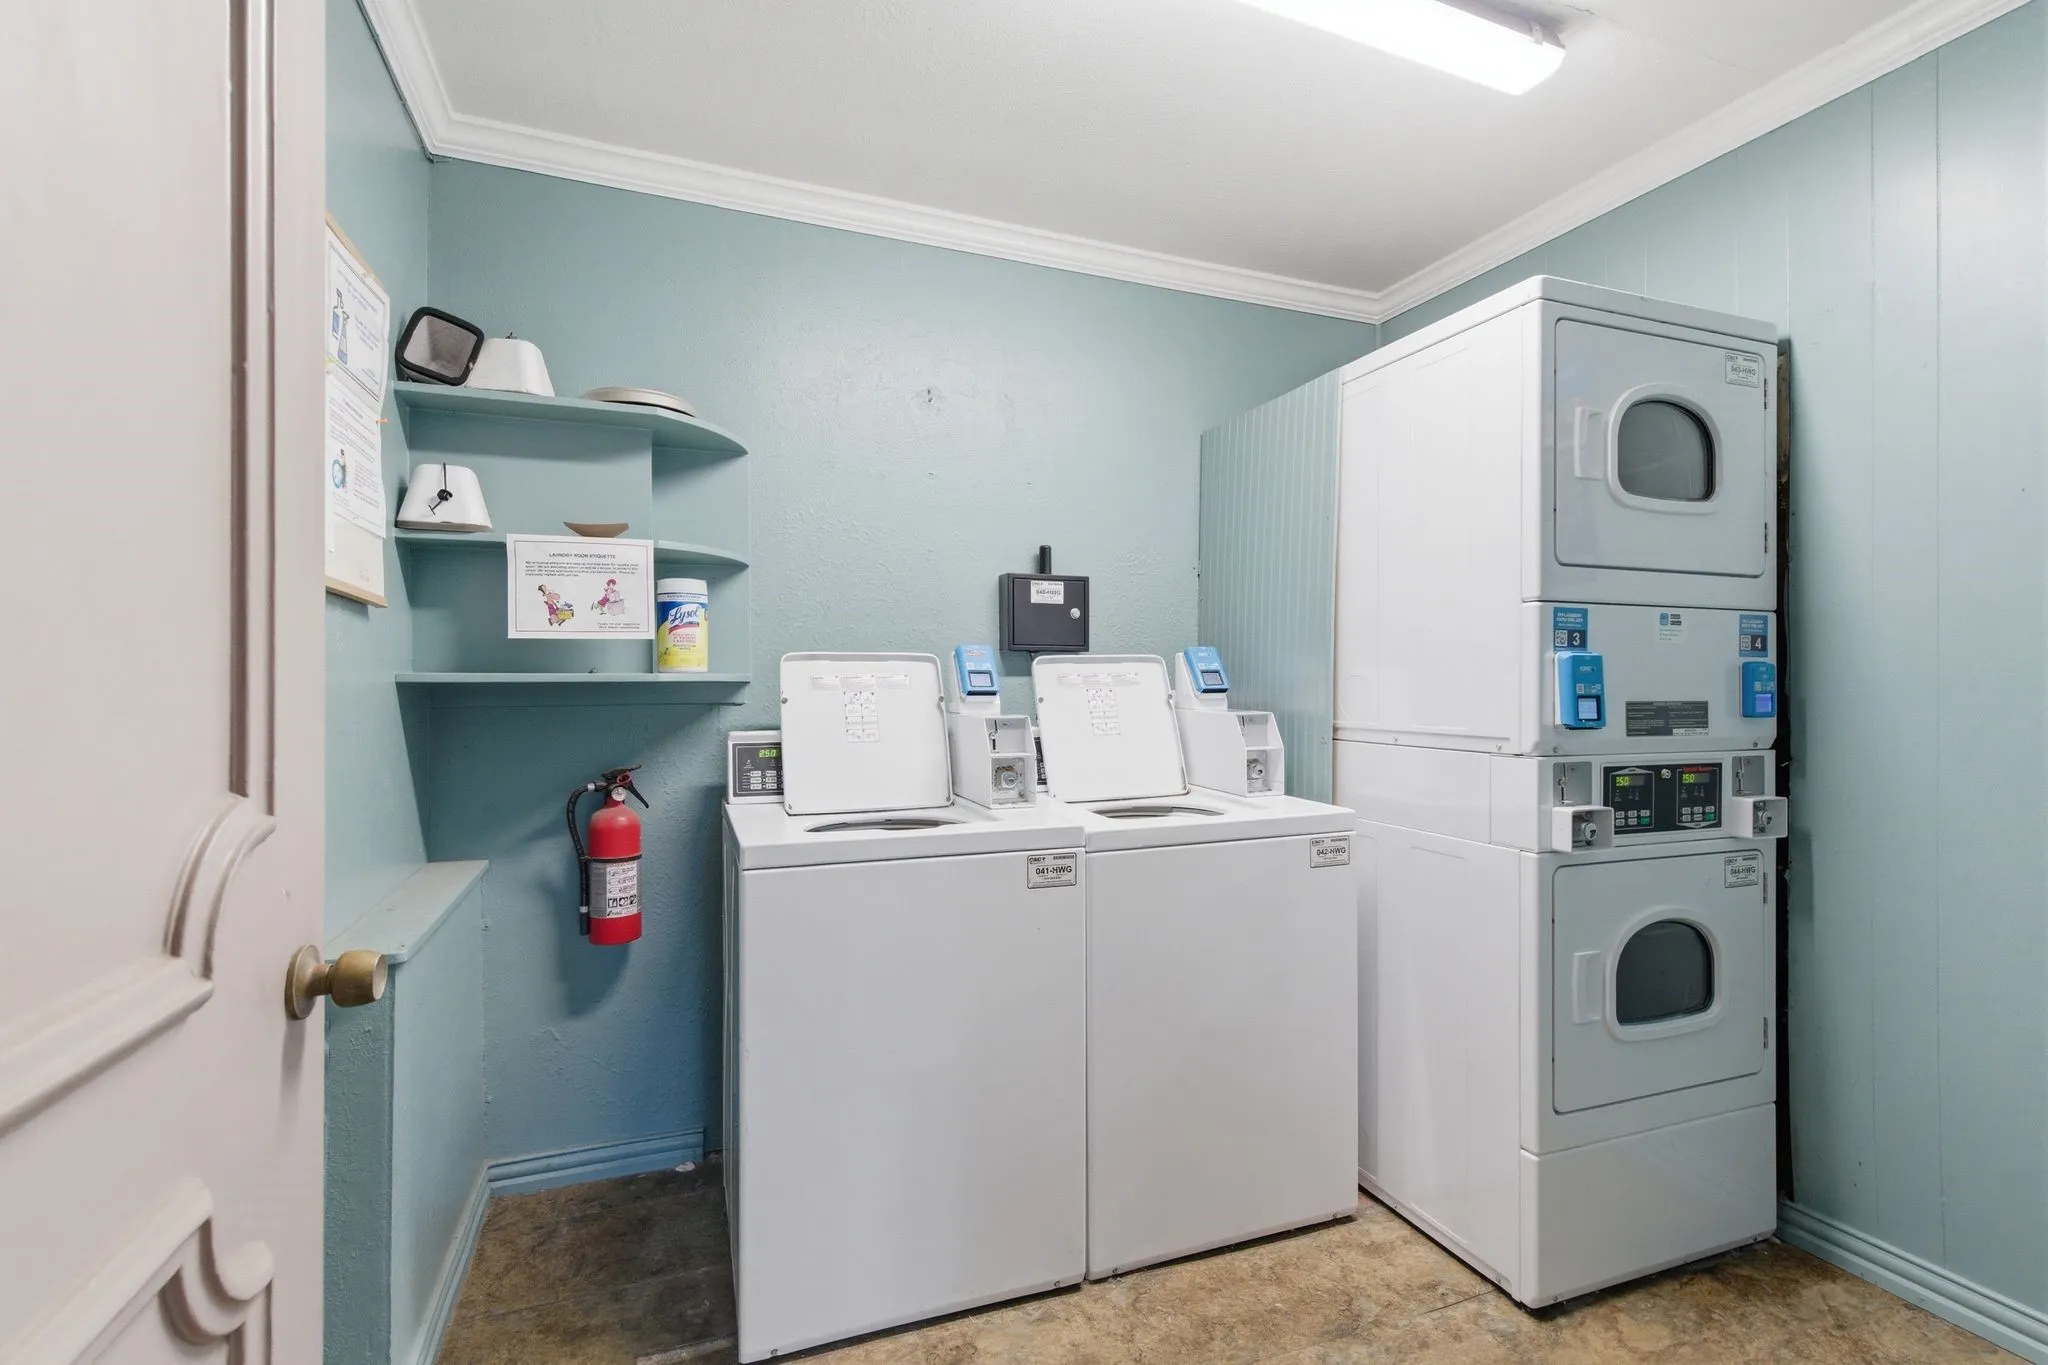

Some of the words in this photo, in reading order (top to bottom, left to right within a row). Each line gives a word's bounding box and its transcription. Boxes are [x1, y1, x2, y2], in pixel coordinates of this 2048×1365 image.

[669, 606, 698, 624] Lysol
[1572, 632, 1581, 646] 3
[1755, 637, 1762, 650] 4
[1035, 865, 1072, 876] 041-HWG
